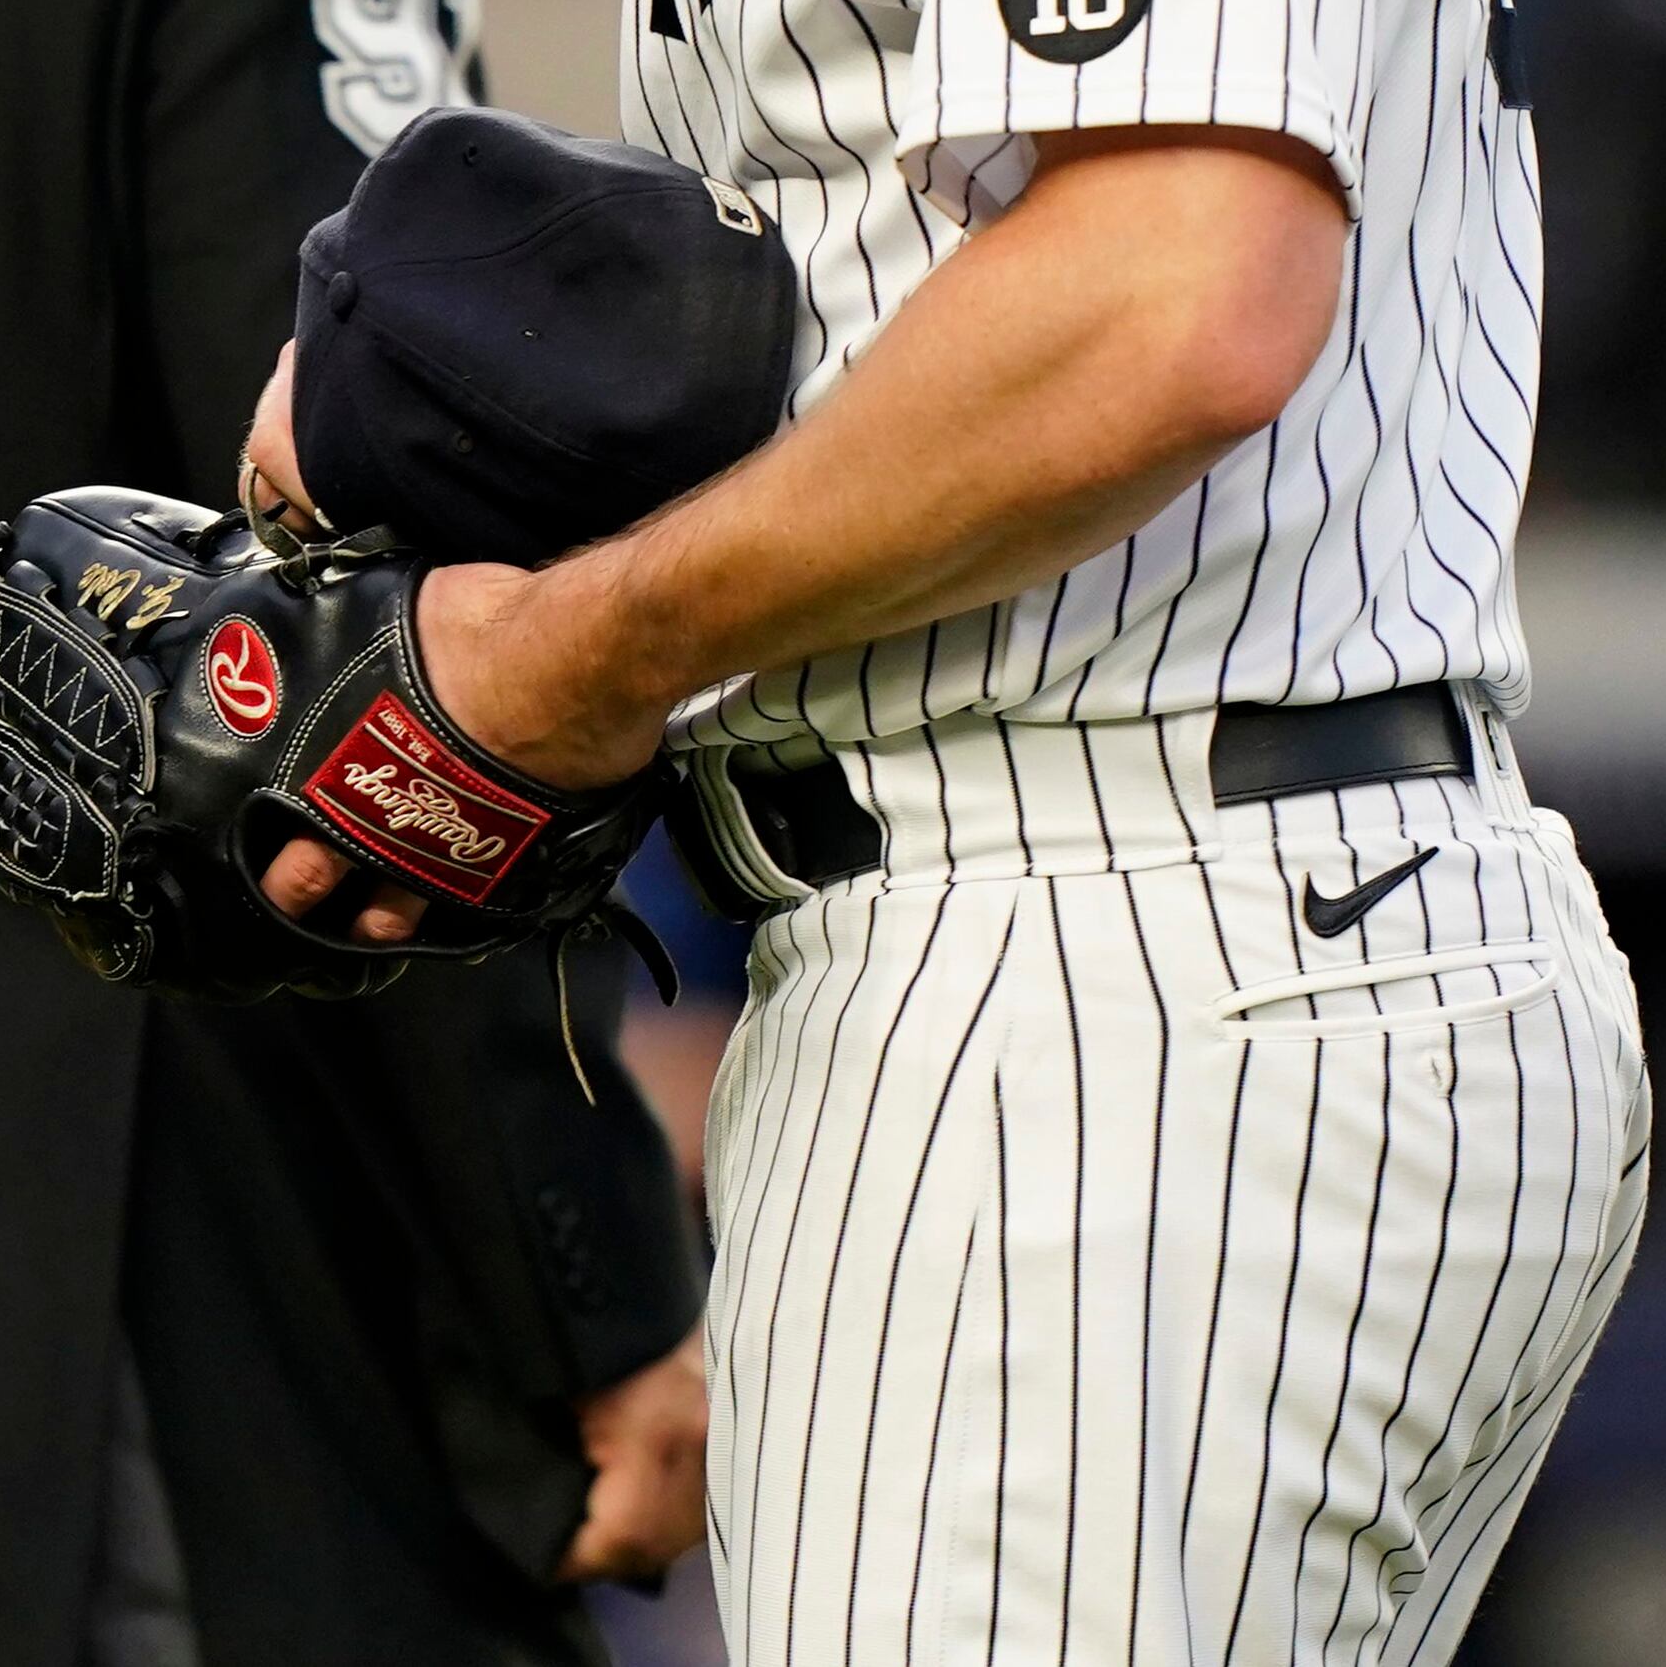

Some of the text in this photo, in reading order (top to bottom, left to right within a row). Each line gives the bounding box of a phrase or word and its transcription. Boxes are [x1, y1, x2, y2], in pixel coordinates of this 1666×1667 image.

[211, 629, 273, 719] R
[378, 709, 407, 740] 1887
[344, 763, 506, 863] Rawlings
